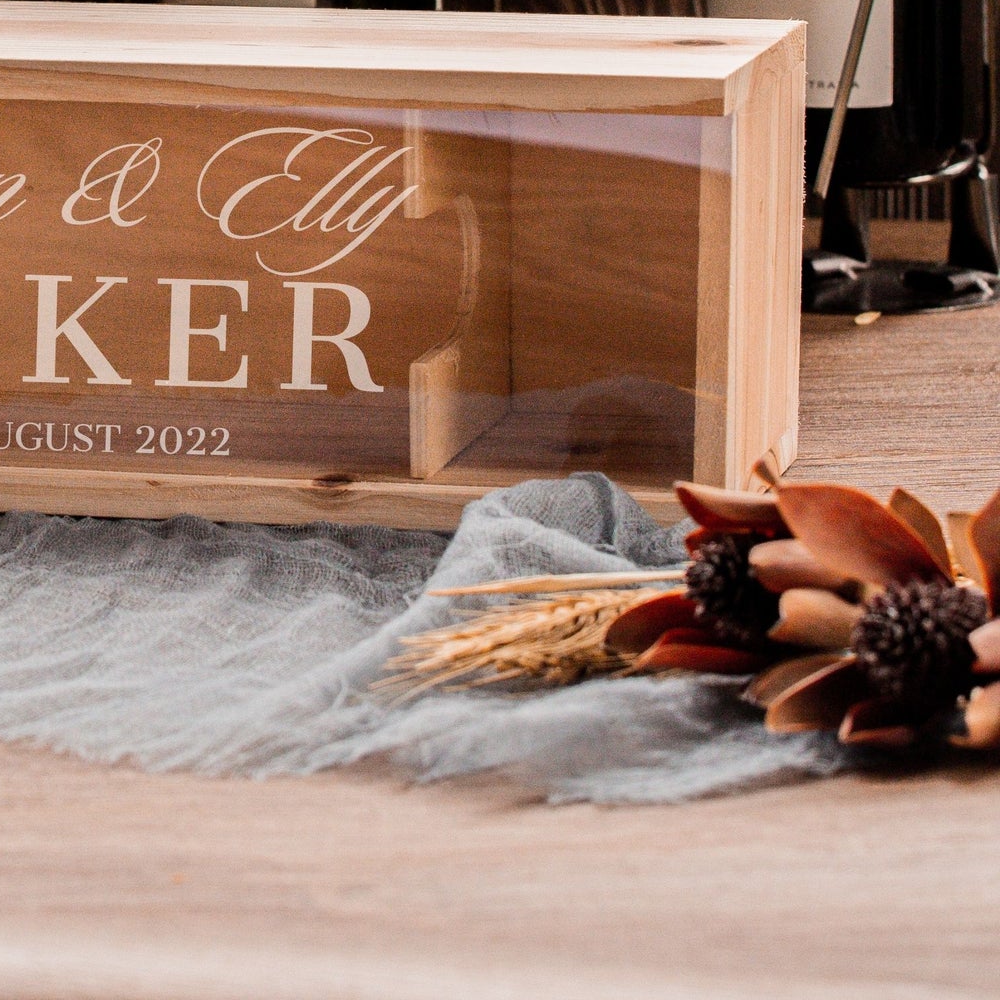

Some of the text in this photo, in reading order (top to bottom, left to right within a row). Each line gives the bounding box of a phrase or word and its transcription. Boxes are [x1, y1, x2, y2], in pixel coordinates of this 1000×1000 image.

[61, 137, 162, 227] &
[197, 127, 420, 276] Elly
[135, 426, 231, 456] 2022
